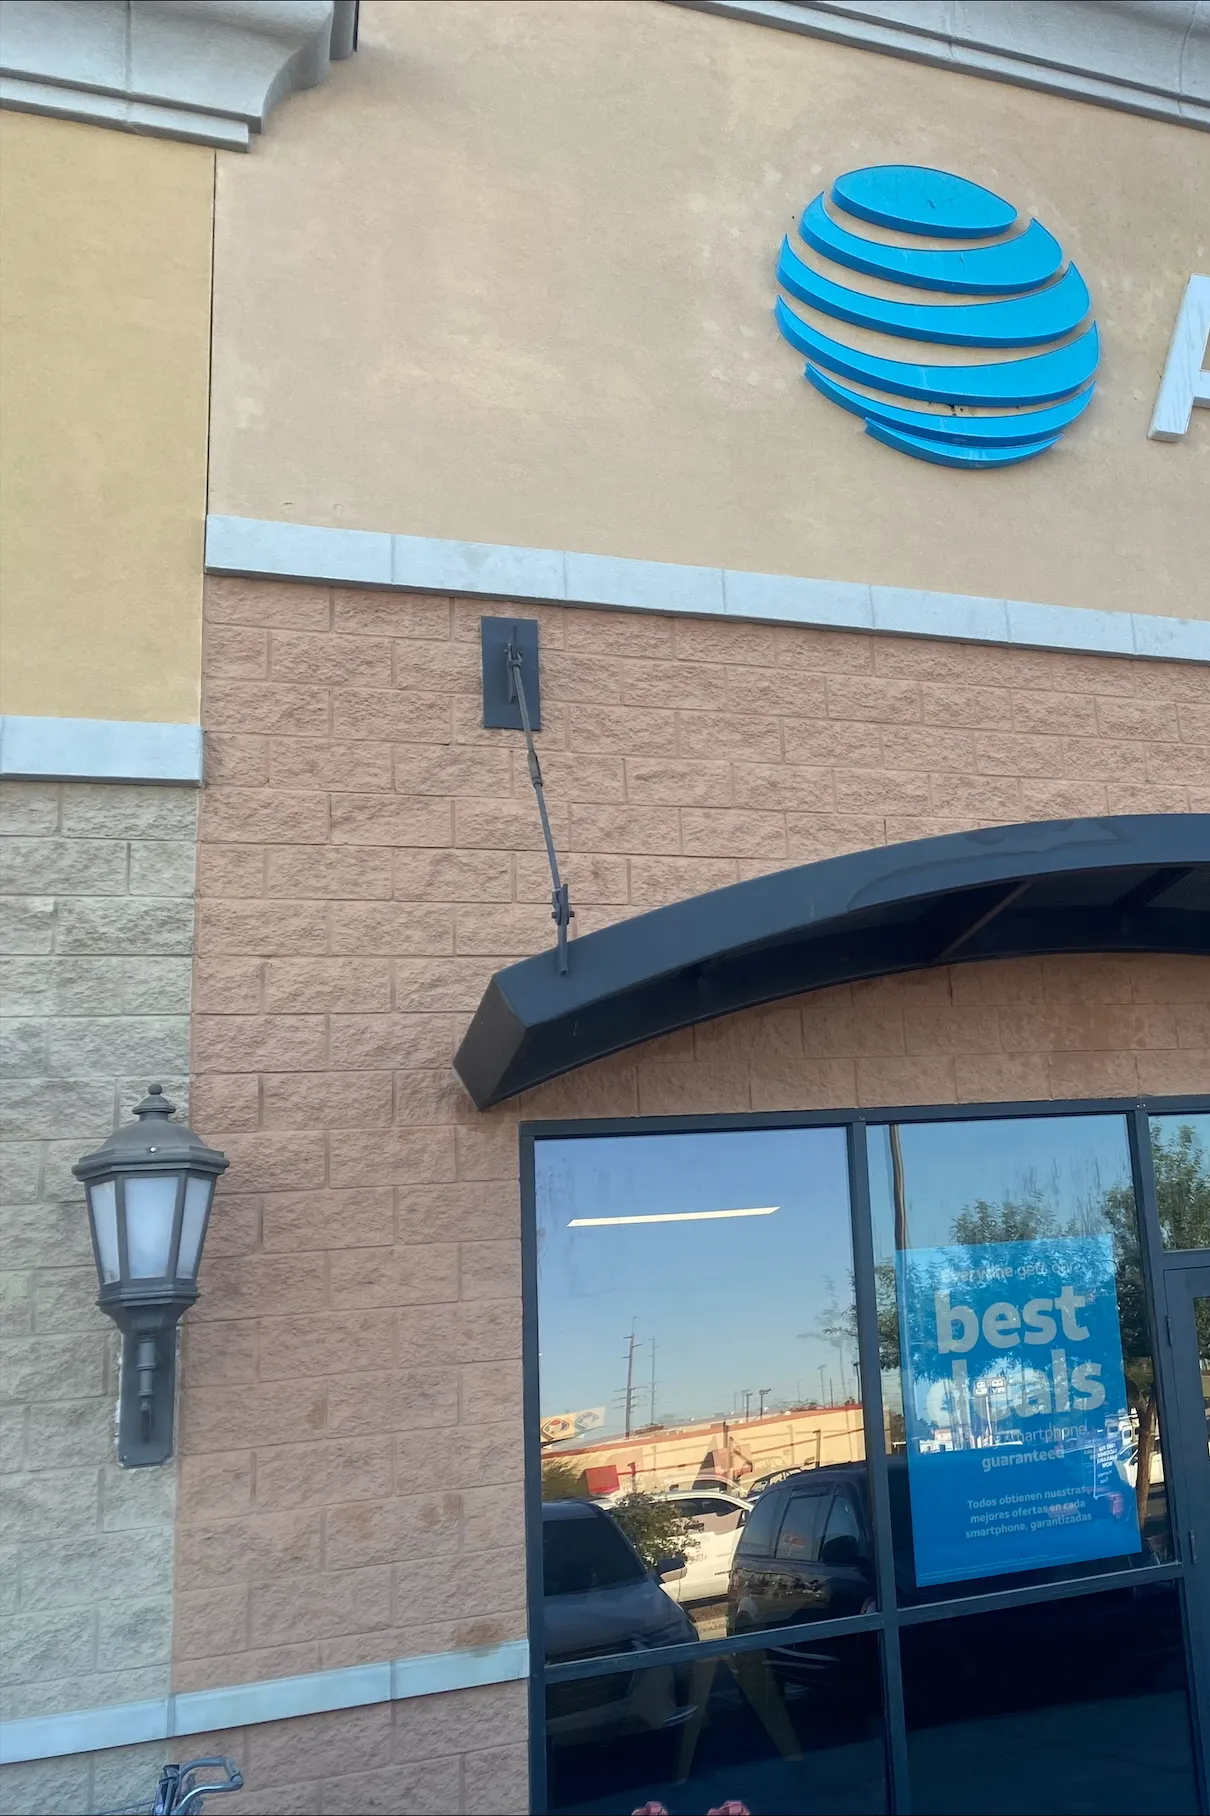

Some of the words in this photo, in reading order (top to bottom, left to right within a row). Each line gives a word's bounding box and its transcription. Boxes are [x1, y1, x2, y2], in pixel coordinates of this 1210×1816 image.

[934, 1285, 1091, 1355] best
[925, 1348, 1107, 1427] deals
[968, 1499, 997, 1510] Todos
[999, 1492, 1043, 1506] obtienen
[1044, 1485, 1087, 1498] nuestras
[965, 1521, 1028, 1539] smartphone,
[1030, 1512, 1093, 1532] garantizadas
[970, 1510, 1010, 1525] mejores
[1012, 1505, 1048, 1518] ofertas
[1049, 1503, 1062, 1513] en
[1063, 1499, 1086, 1511] cada
